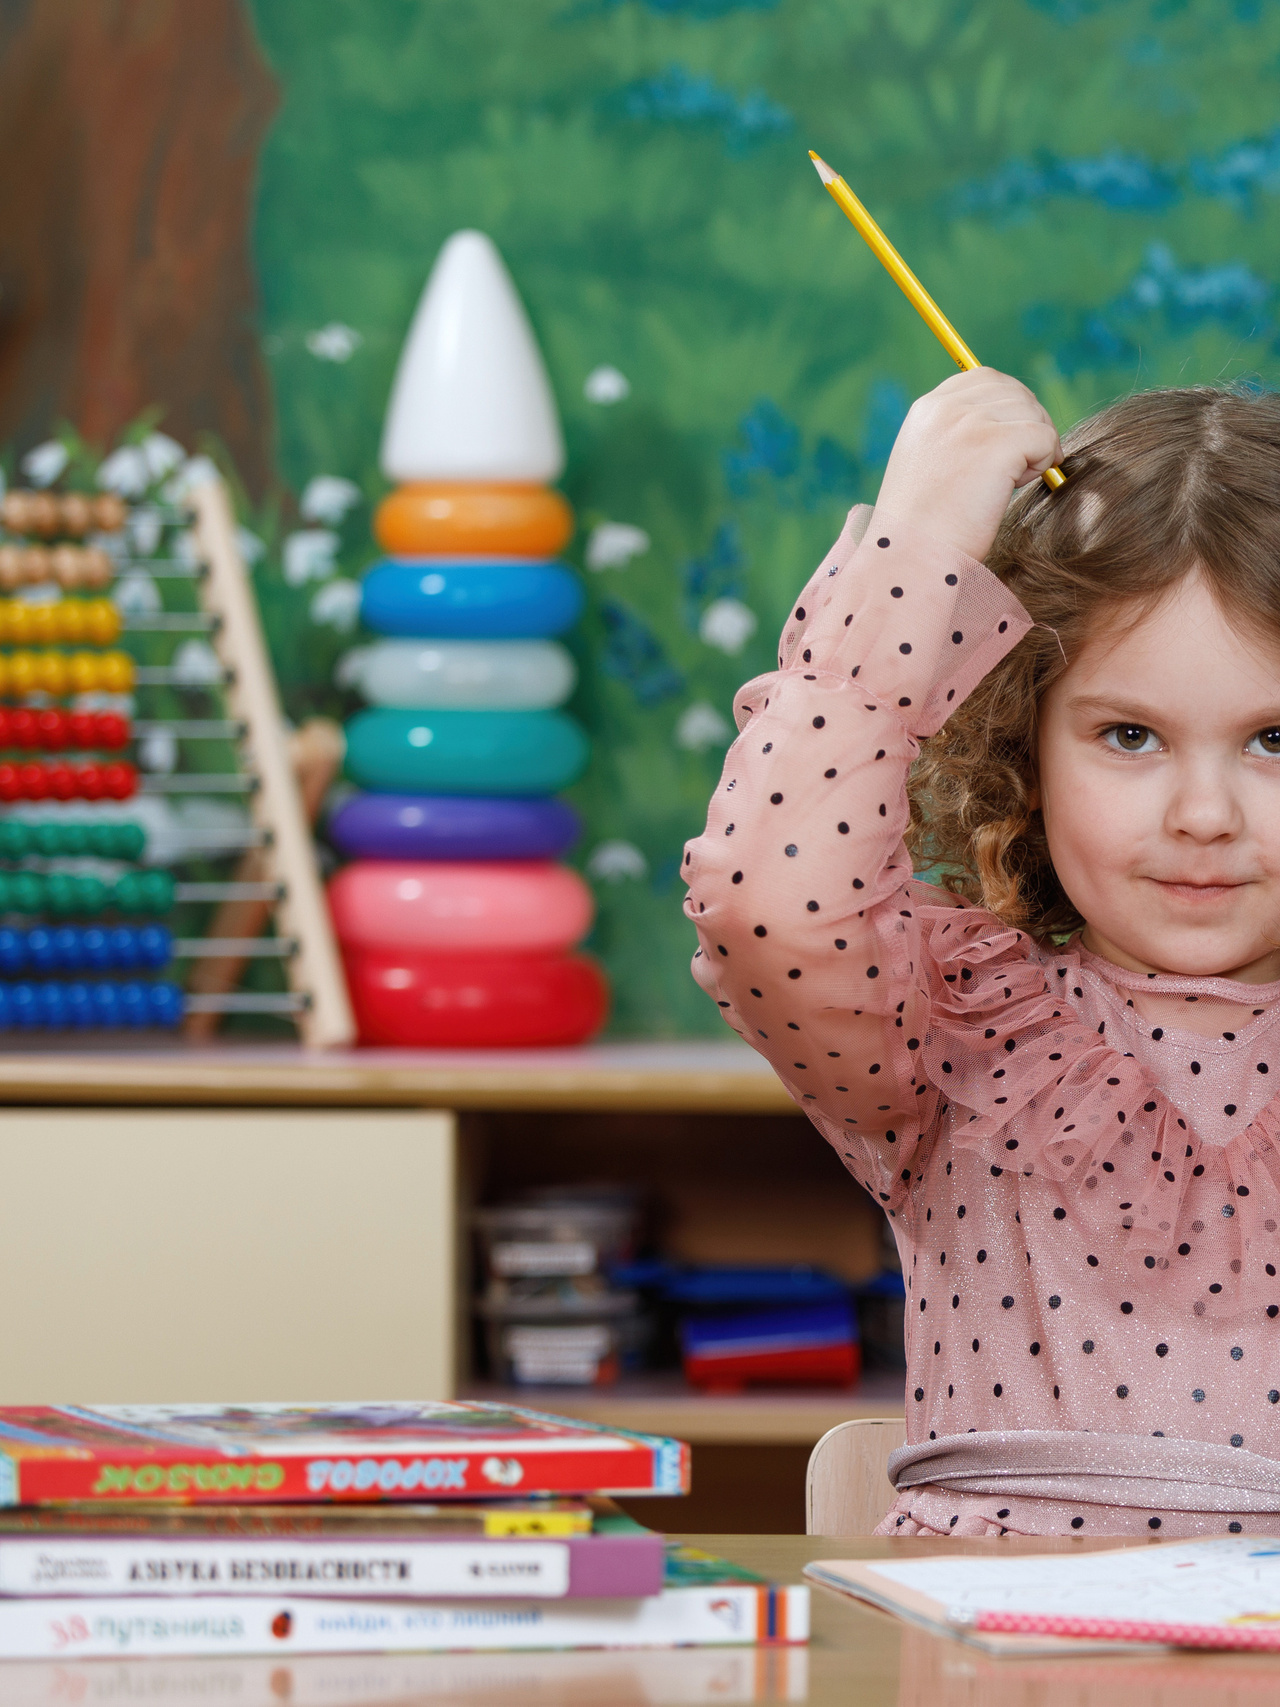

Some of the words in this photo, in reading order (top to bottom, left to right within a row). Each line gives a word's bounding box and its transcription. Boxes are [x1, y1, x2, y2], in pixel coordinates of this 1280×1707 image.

[95, 1463, 285, 1494] СКАЗОК
[306, 1458, 469, 1490] ХОРОВОД
[128, 1559, 221, 1582] АЗБУКА
[230, 1559, 412, 1581] БЕЗОПАСНОСТИ
